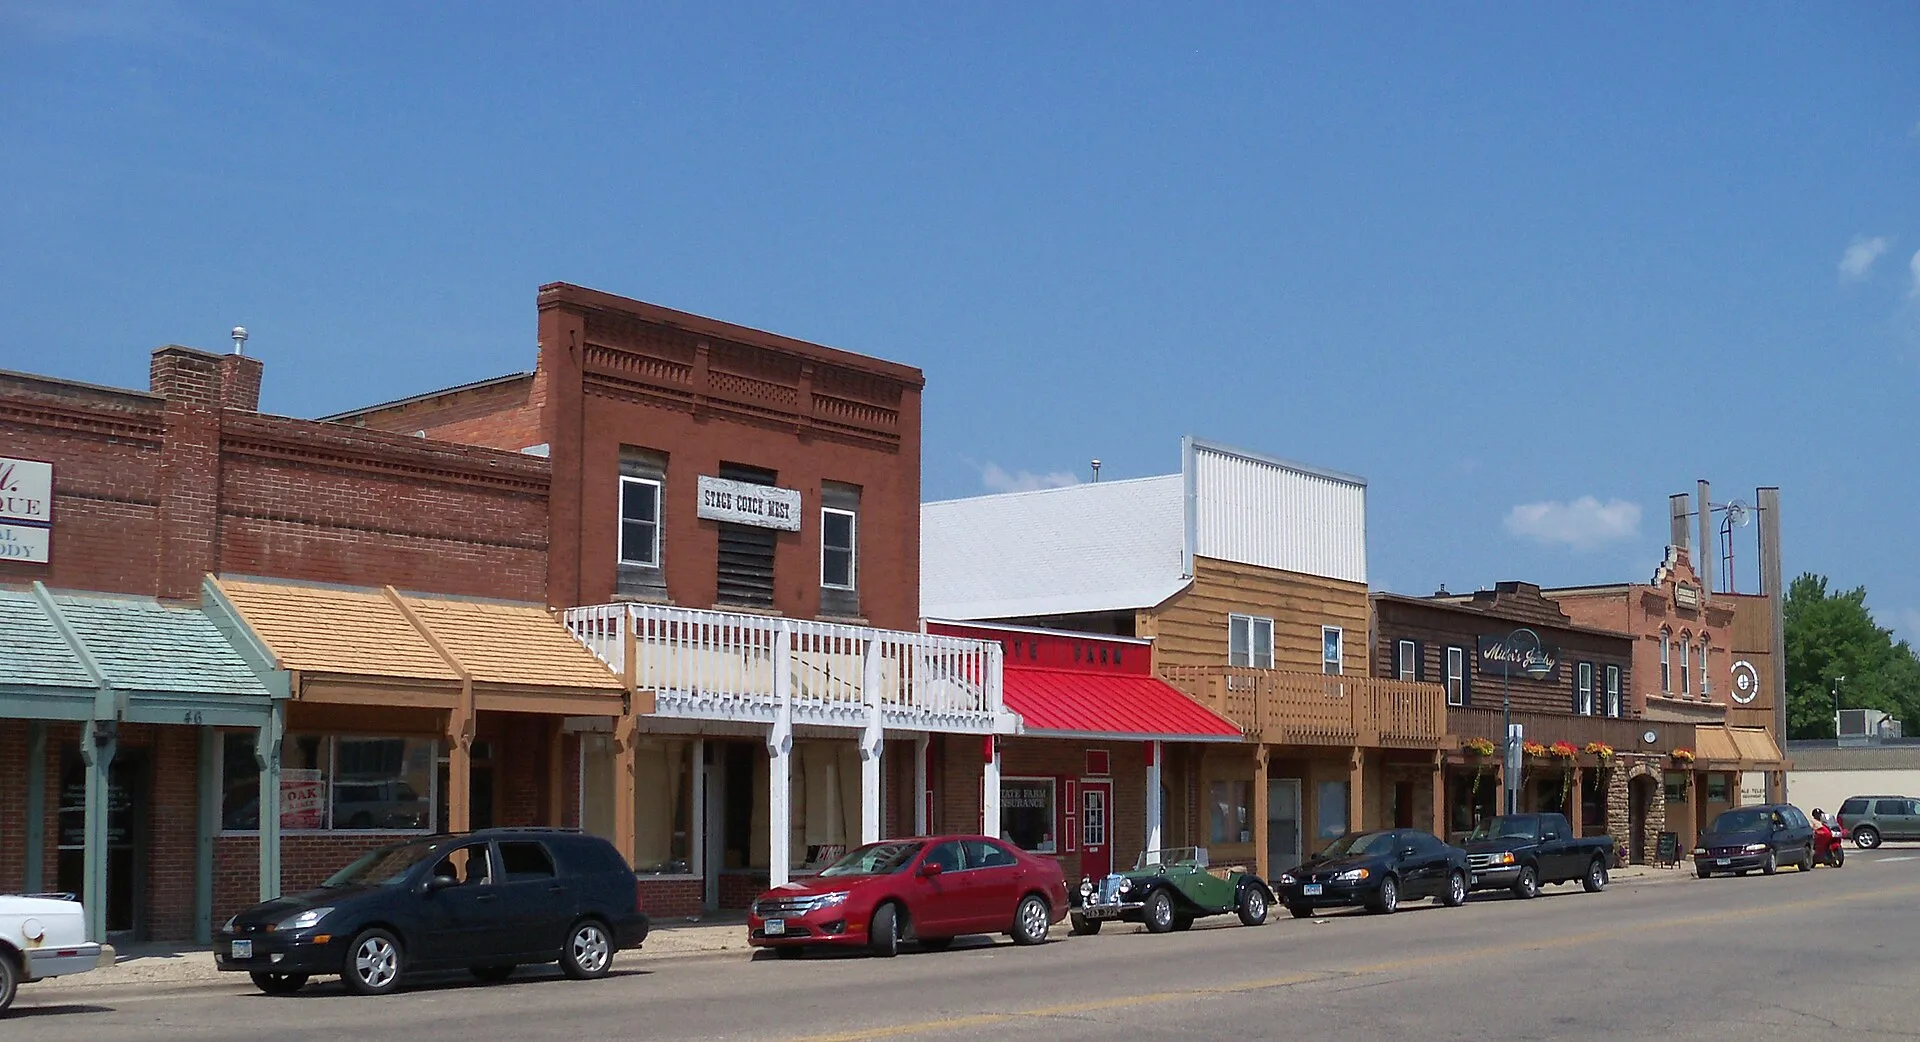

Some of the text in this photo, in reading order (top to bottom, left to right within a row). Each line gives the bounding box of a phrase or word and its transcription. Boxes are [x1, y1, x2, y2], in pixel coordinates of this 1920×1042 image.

[0, 497, 40, 515] UE
[705, 490, 732, 510] STAGE
[737, 495, 763, 515] COACH
[288, 788, 317, 800] OAK
[1000, 789, 1046, 798] TATE FARM
[1000, 799, 1045, 808] NSURANCE
